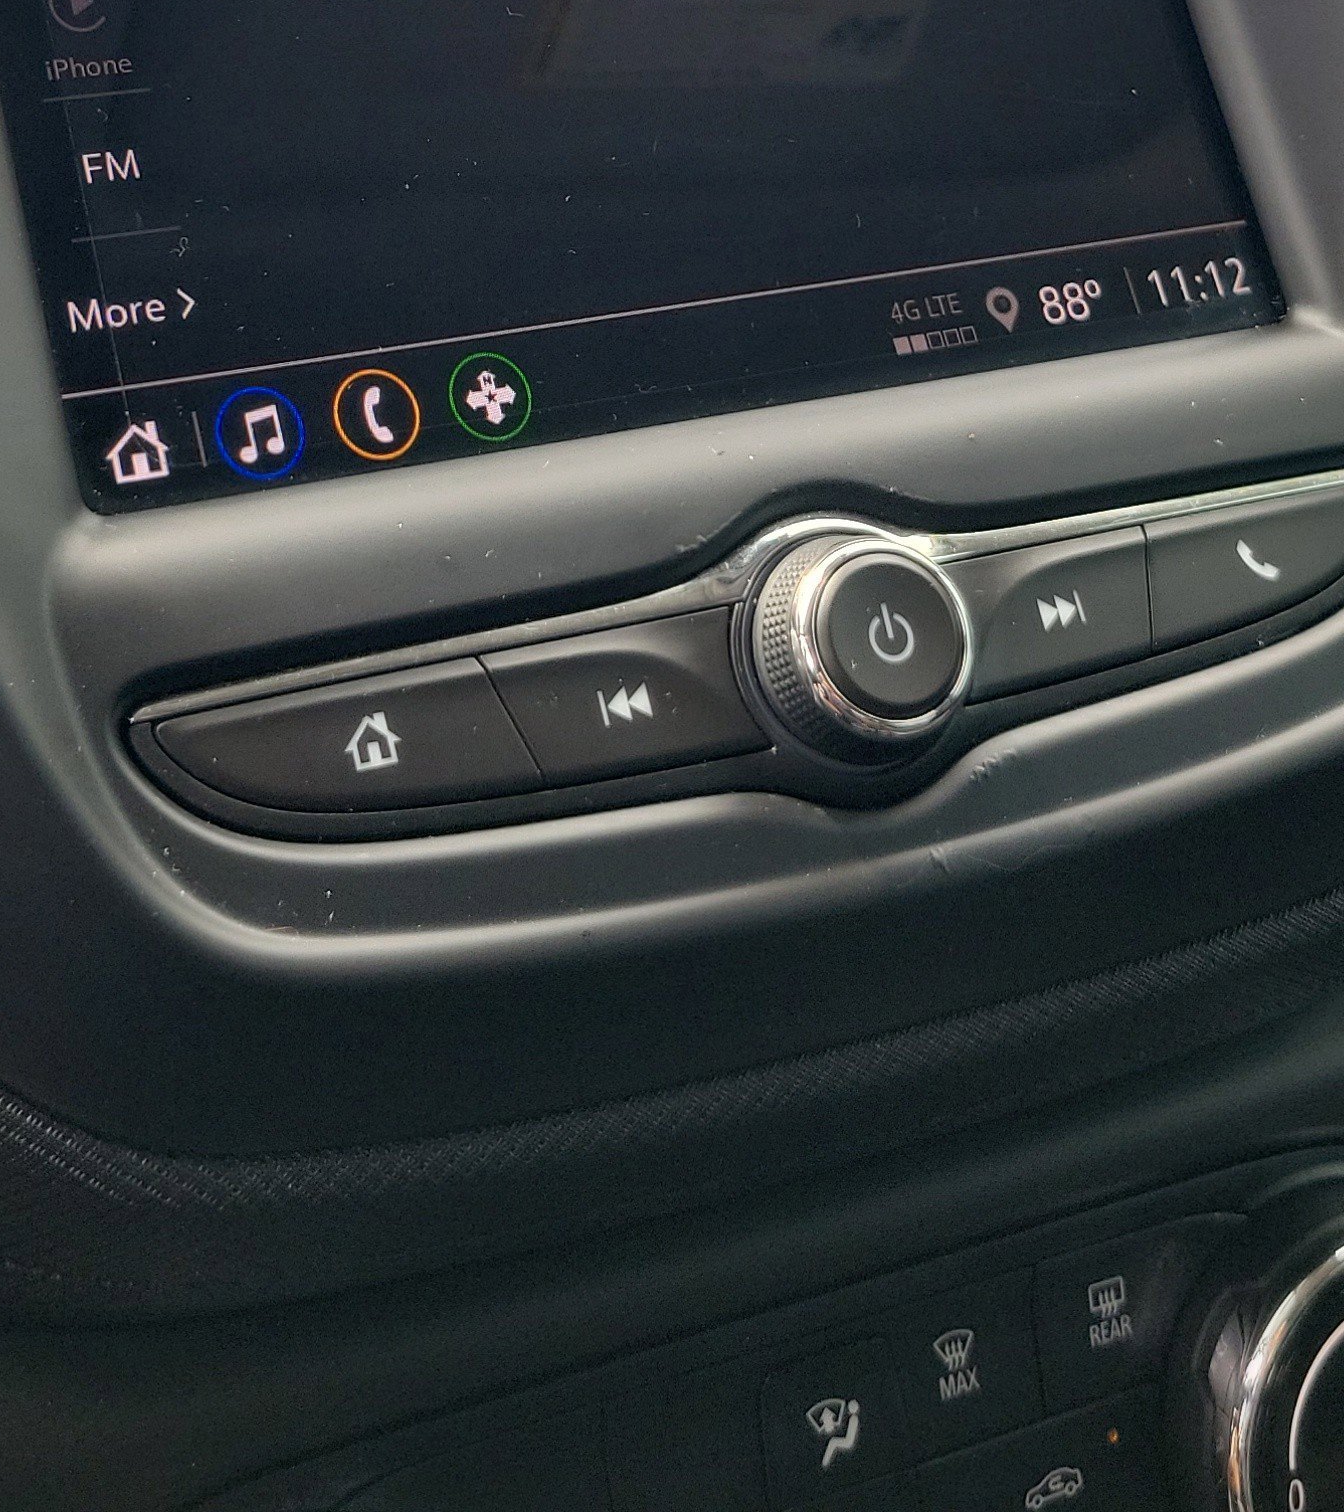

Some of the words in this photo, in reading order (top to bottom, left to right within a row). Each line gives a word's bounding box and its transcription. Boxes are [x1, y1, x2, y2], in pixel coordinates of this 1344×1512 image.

[43, 55, 134, 82] iPhone
[81, 148, 142, 185] FM
[1146, 256, 1253, 308] 11:12
[65, 297, 167, 334] More
[890, 298, 921, 325] 4G
[925, 292, 964, 317] LTE
[1088, 1313, 1134, 1348] REAR
[937, 1365, 981, 1401] MAX
